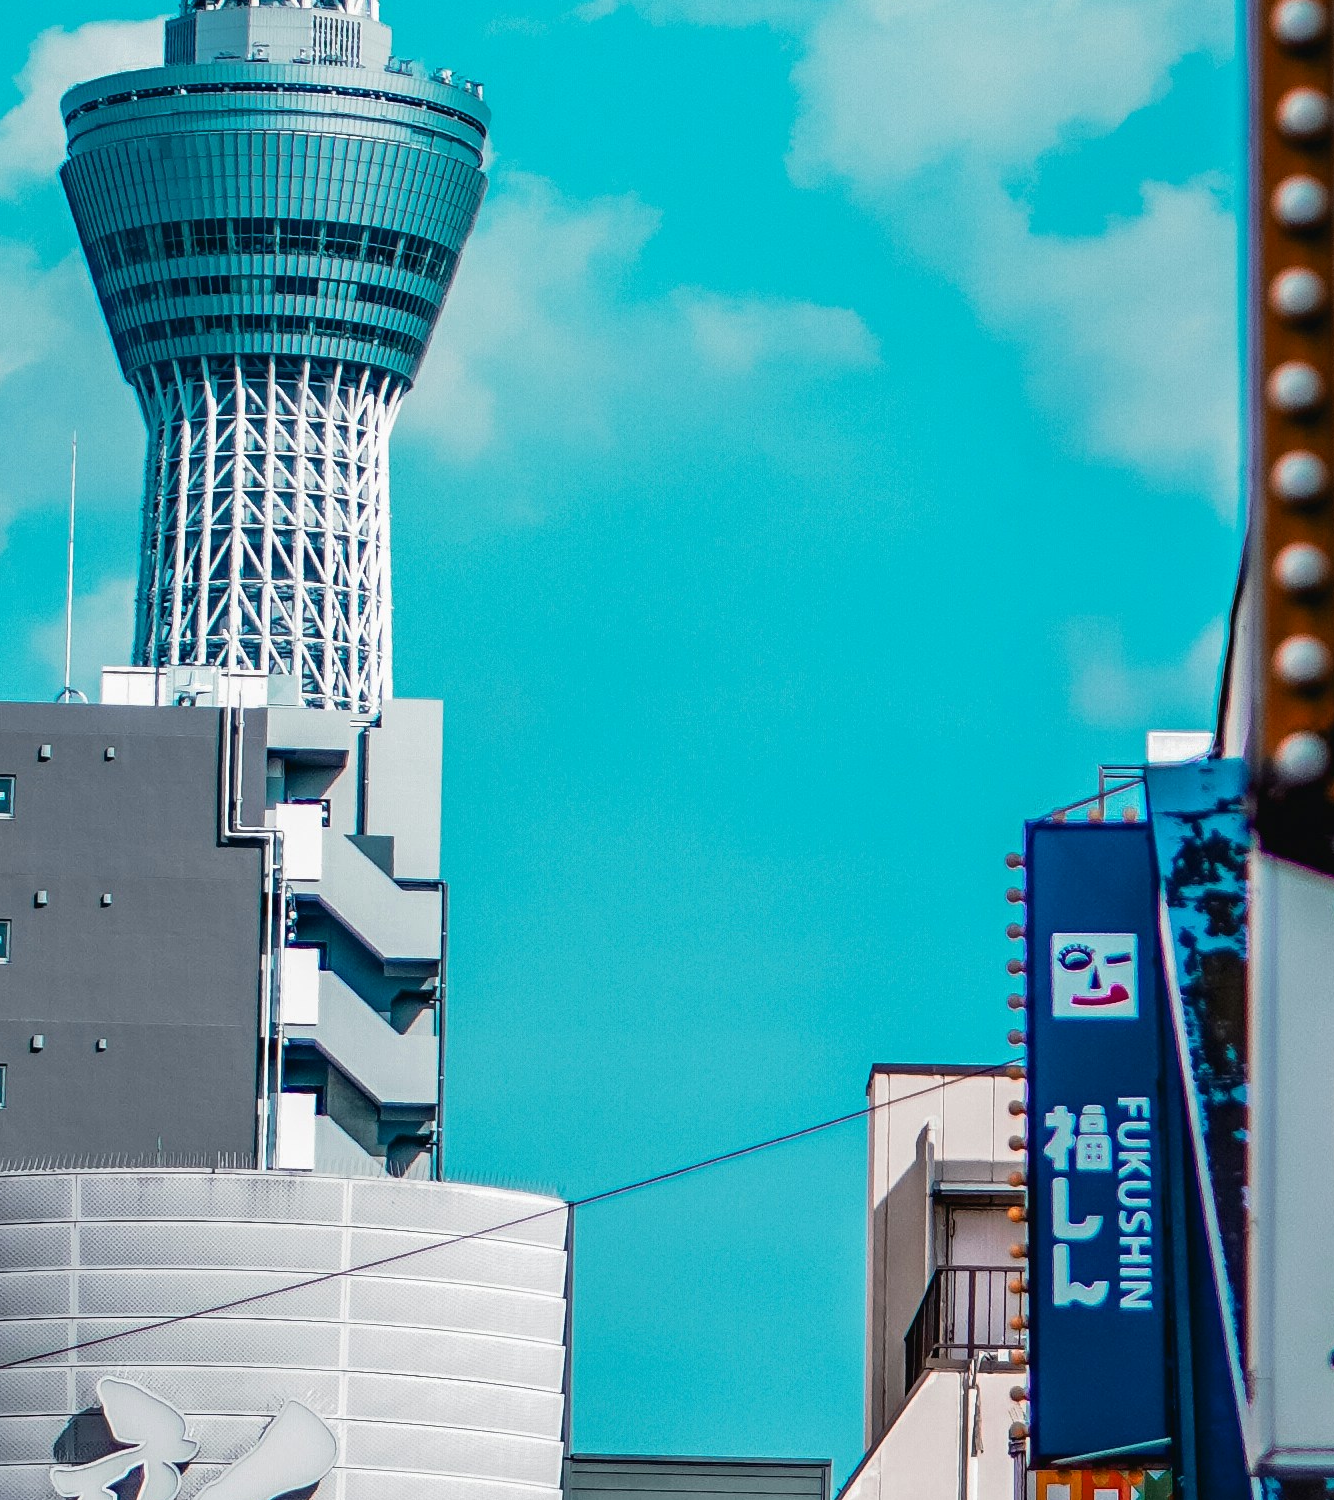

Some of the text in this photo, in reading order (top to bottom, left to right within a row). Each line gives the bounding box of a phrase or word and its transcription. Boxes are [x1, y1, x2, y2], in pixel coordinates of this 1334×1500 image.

[1043, 1103, 1113, 1309] 福しん
[1117, 1096, 1154, 1311] FUKUSHIN
